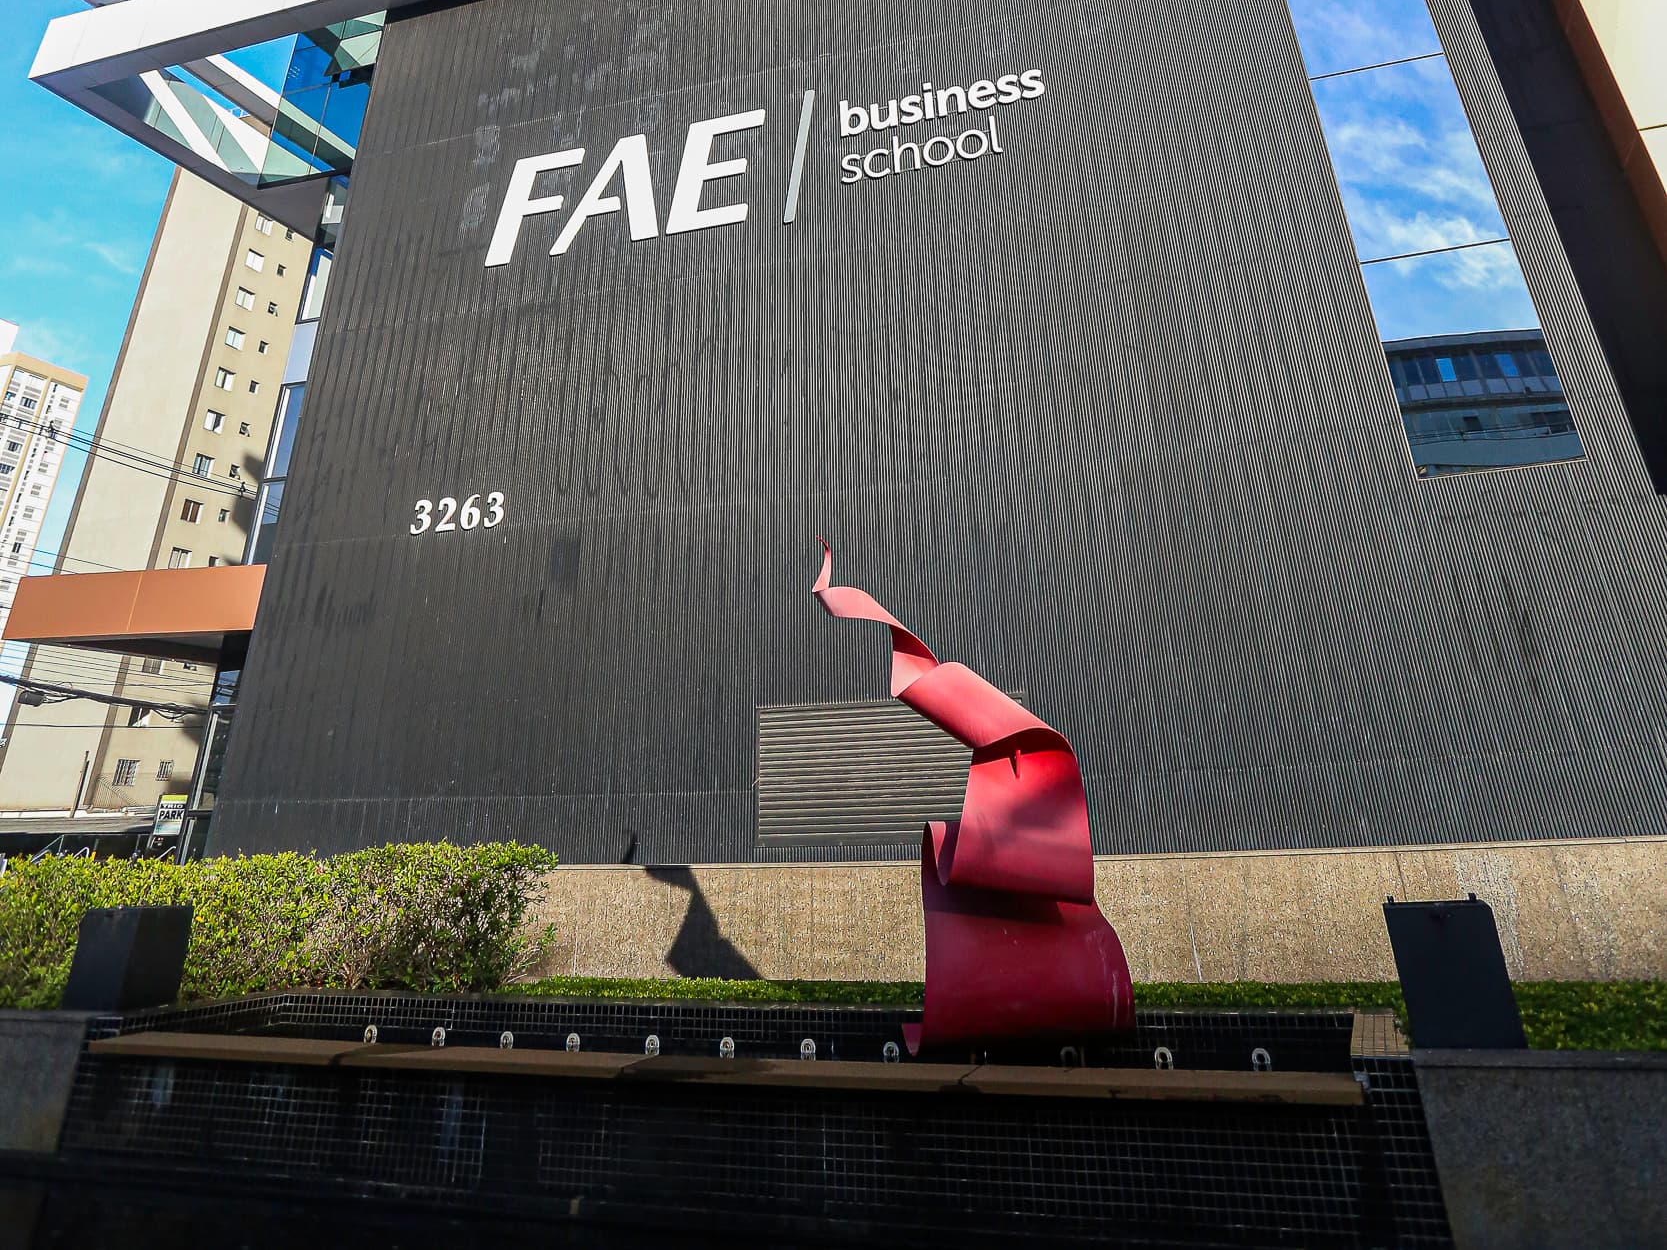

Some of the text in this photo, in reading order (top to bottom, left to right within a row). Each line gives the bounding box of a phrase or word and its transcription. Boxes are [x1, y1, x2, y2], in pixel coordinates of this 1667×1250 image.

[839, 68, 1046, 137] business
[840, 115, 1004, 184] school
[484, 108, 766, 268] FAE
[410, 491, 505, 535] 3263
[159, 810, 184, 820] PARK
